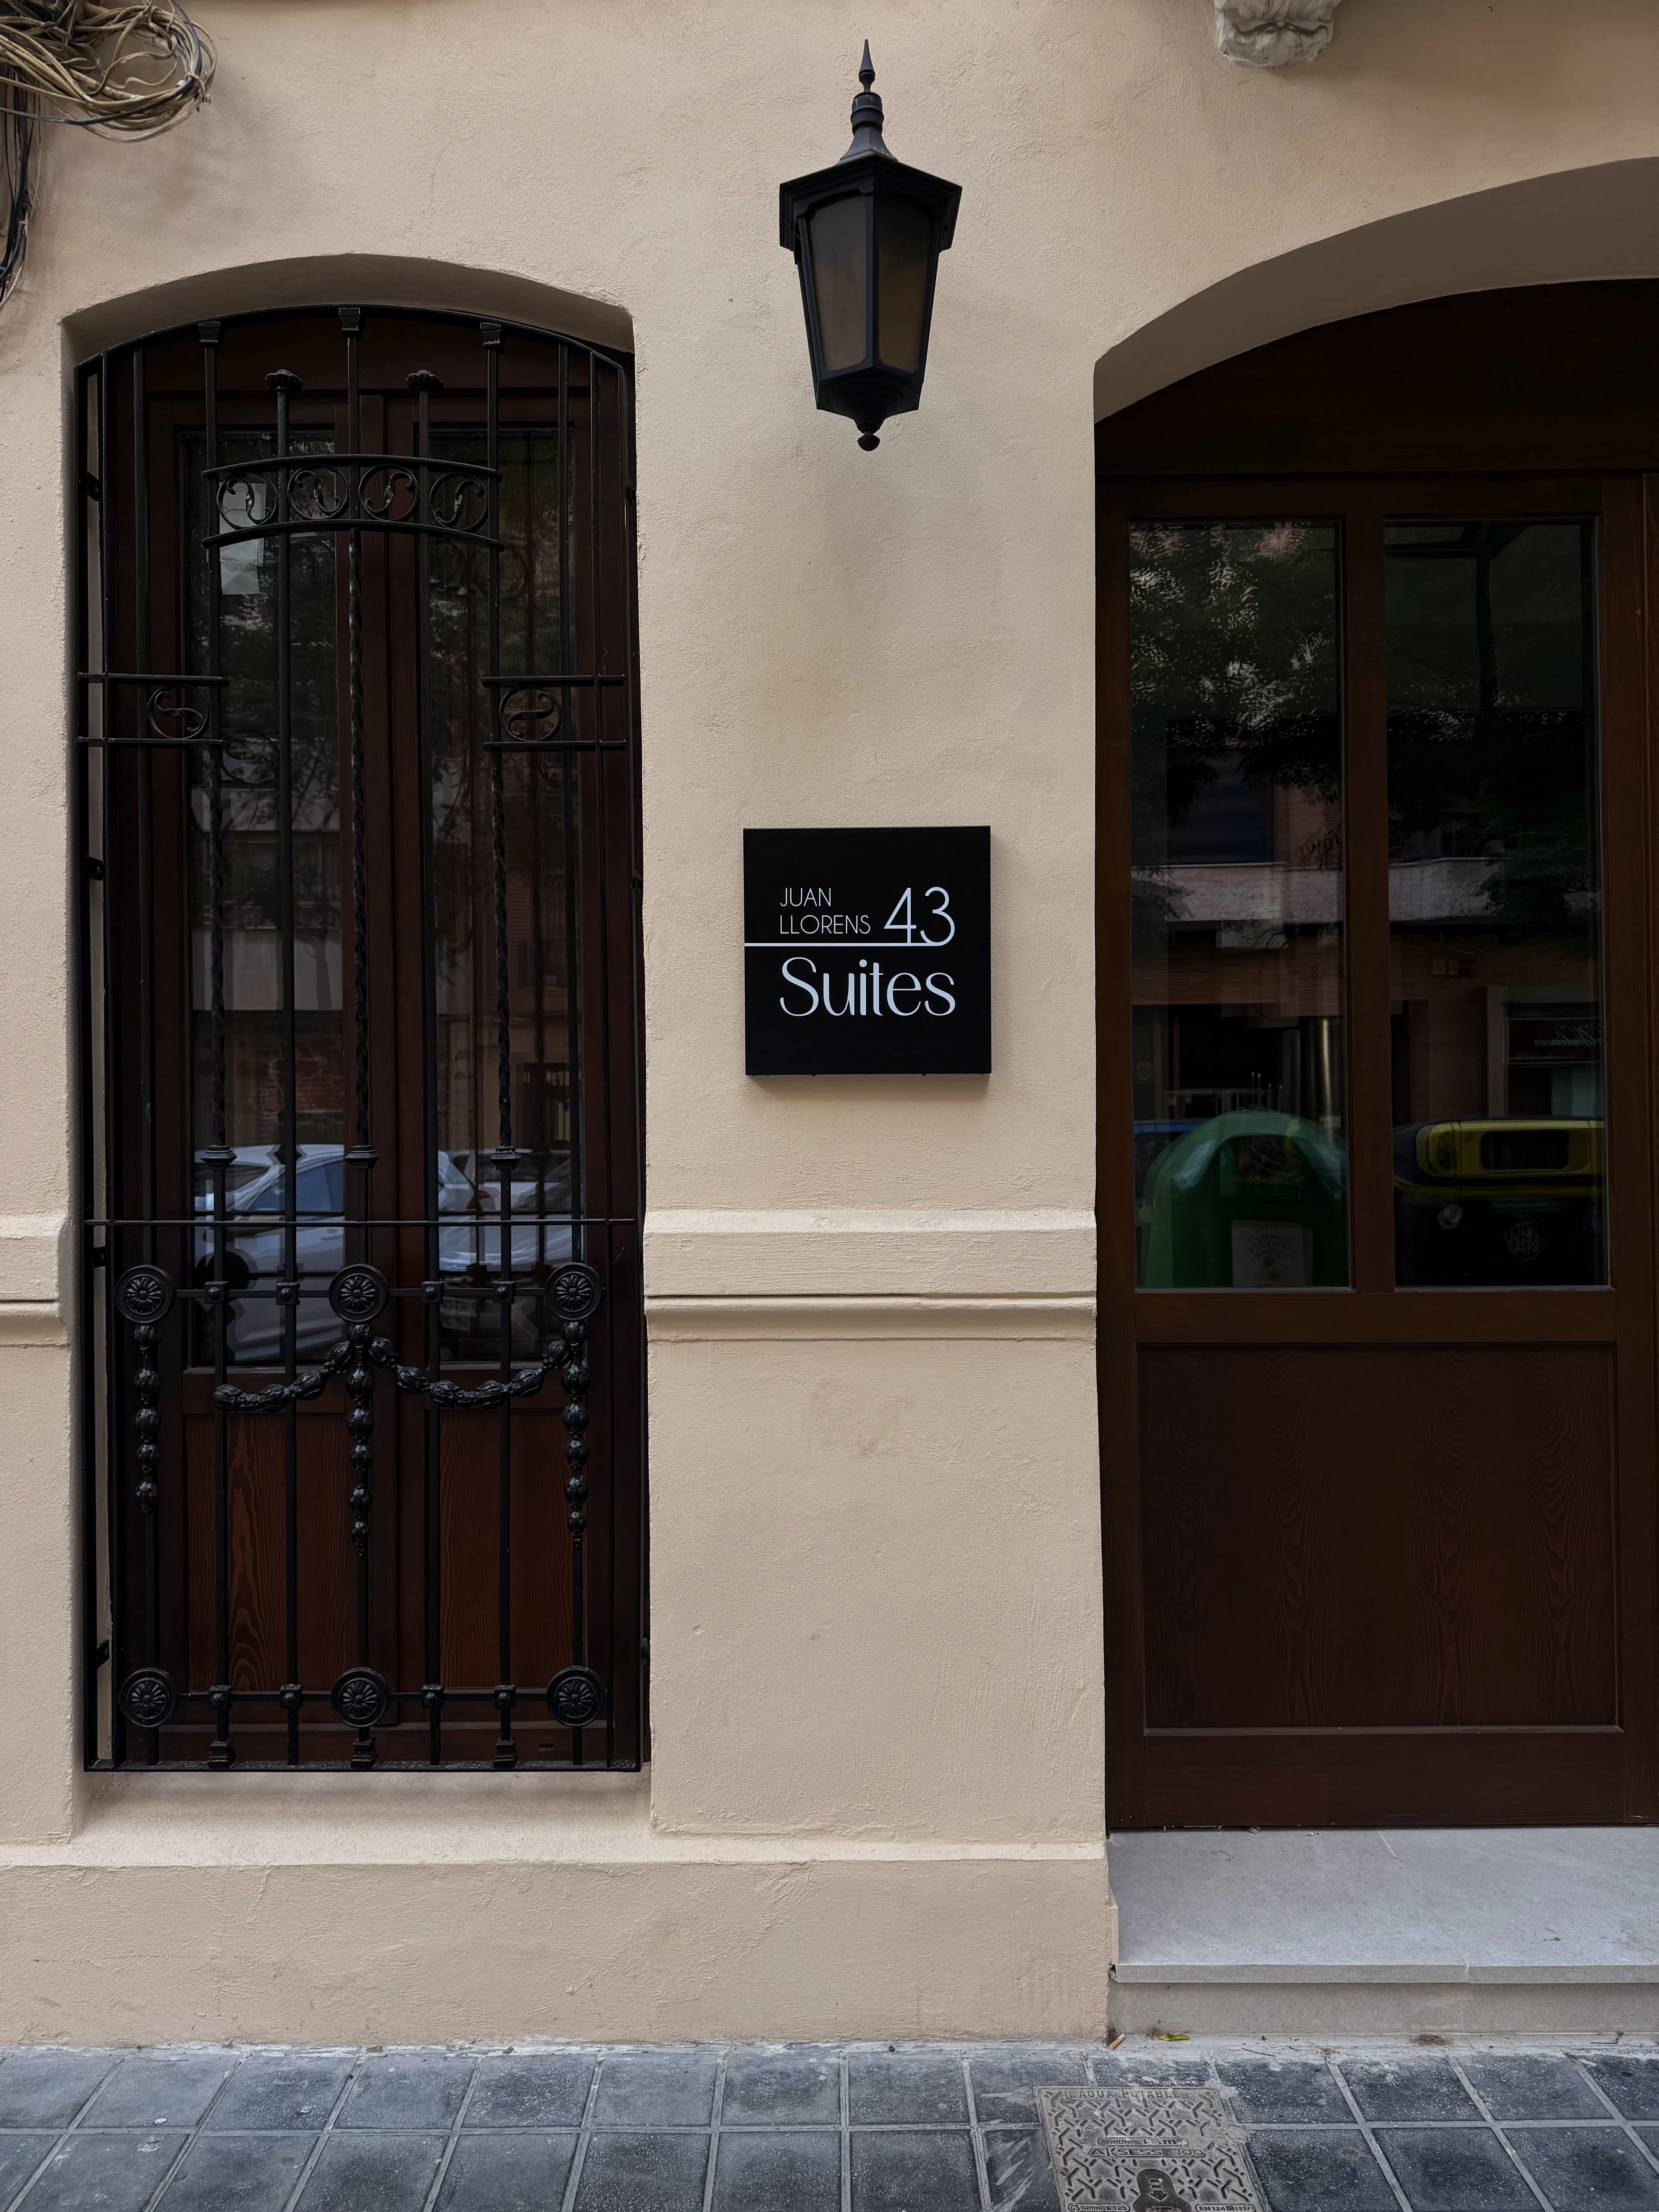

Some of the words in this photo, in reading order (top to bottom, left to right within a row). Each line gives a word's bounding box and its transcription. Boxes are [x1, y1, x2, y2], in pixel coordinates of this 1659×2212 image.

[780, 888, 831, 906] JUAN
[780, 915, 870, 934] LLORENS
[884, 887, 955, 946] 43
[780, 957, 955, 1016] Suites
[1090, 2148, 1162, 2157] AKSESS
